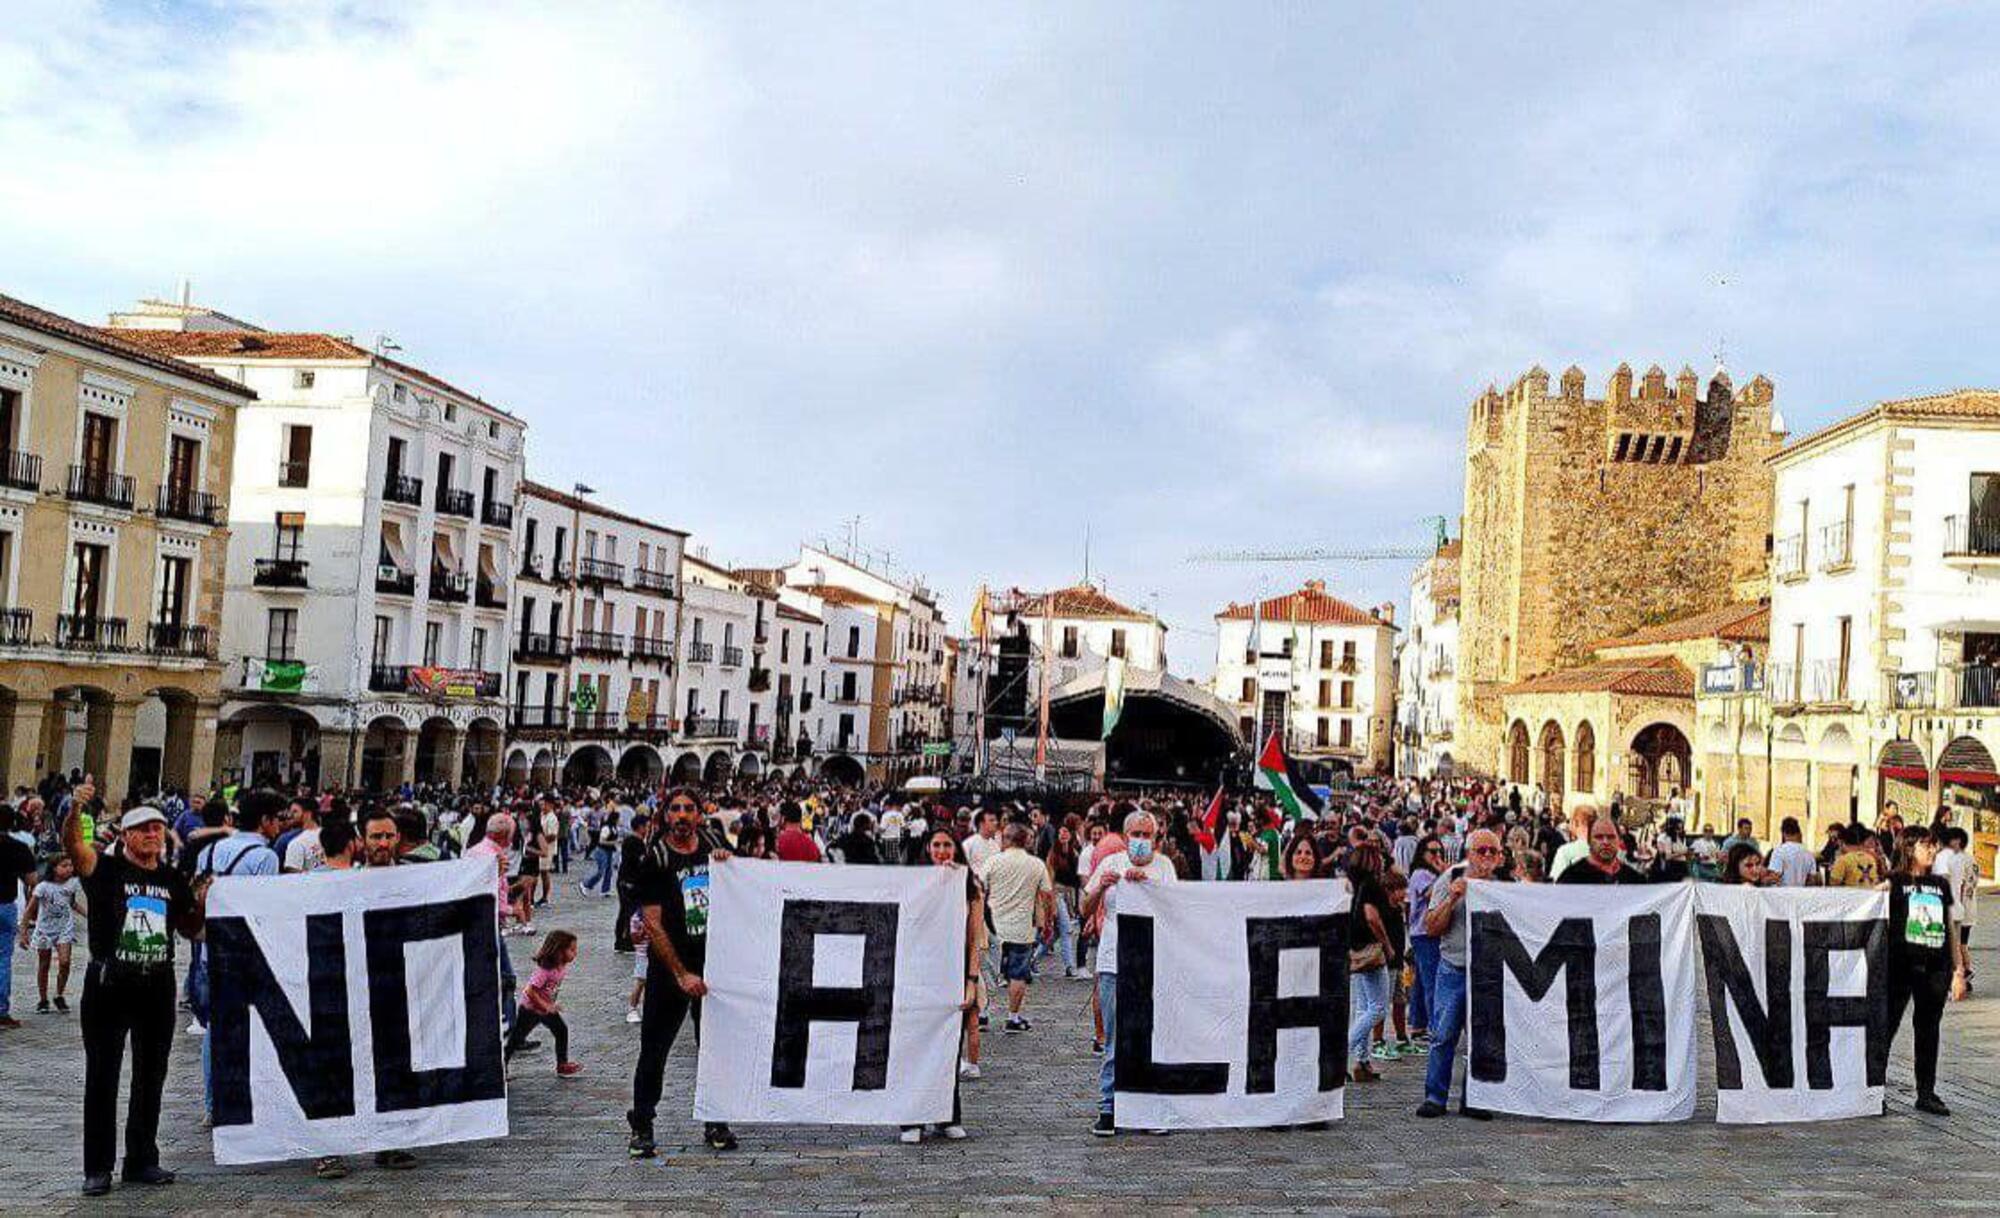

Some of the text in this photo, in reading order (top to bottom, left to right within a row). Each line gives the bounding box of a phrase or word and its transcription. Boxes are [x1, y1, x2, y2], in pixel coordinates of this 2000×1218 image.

[124, 883, 171, 899] NO MINA
[206, 893, 506, 1126] NO
[770, 899, 900, 1091] A
[1115, 913, 1351, 1095] LA
